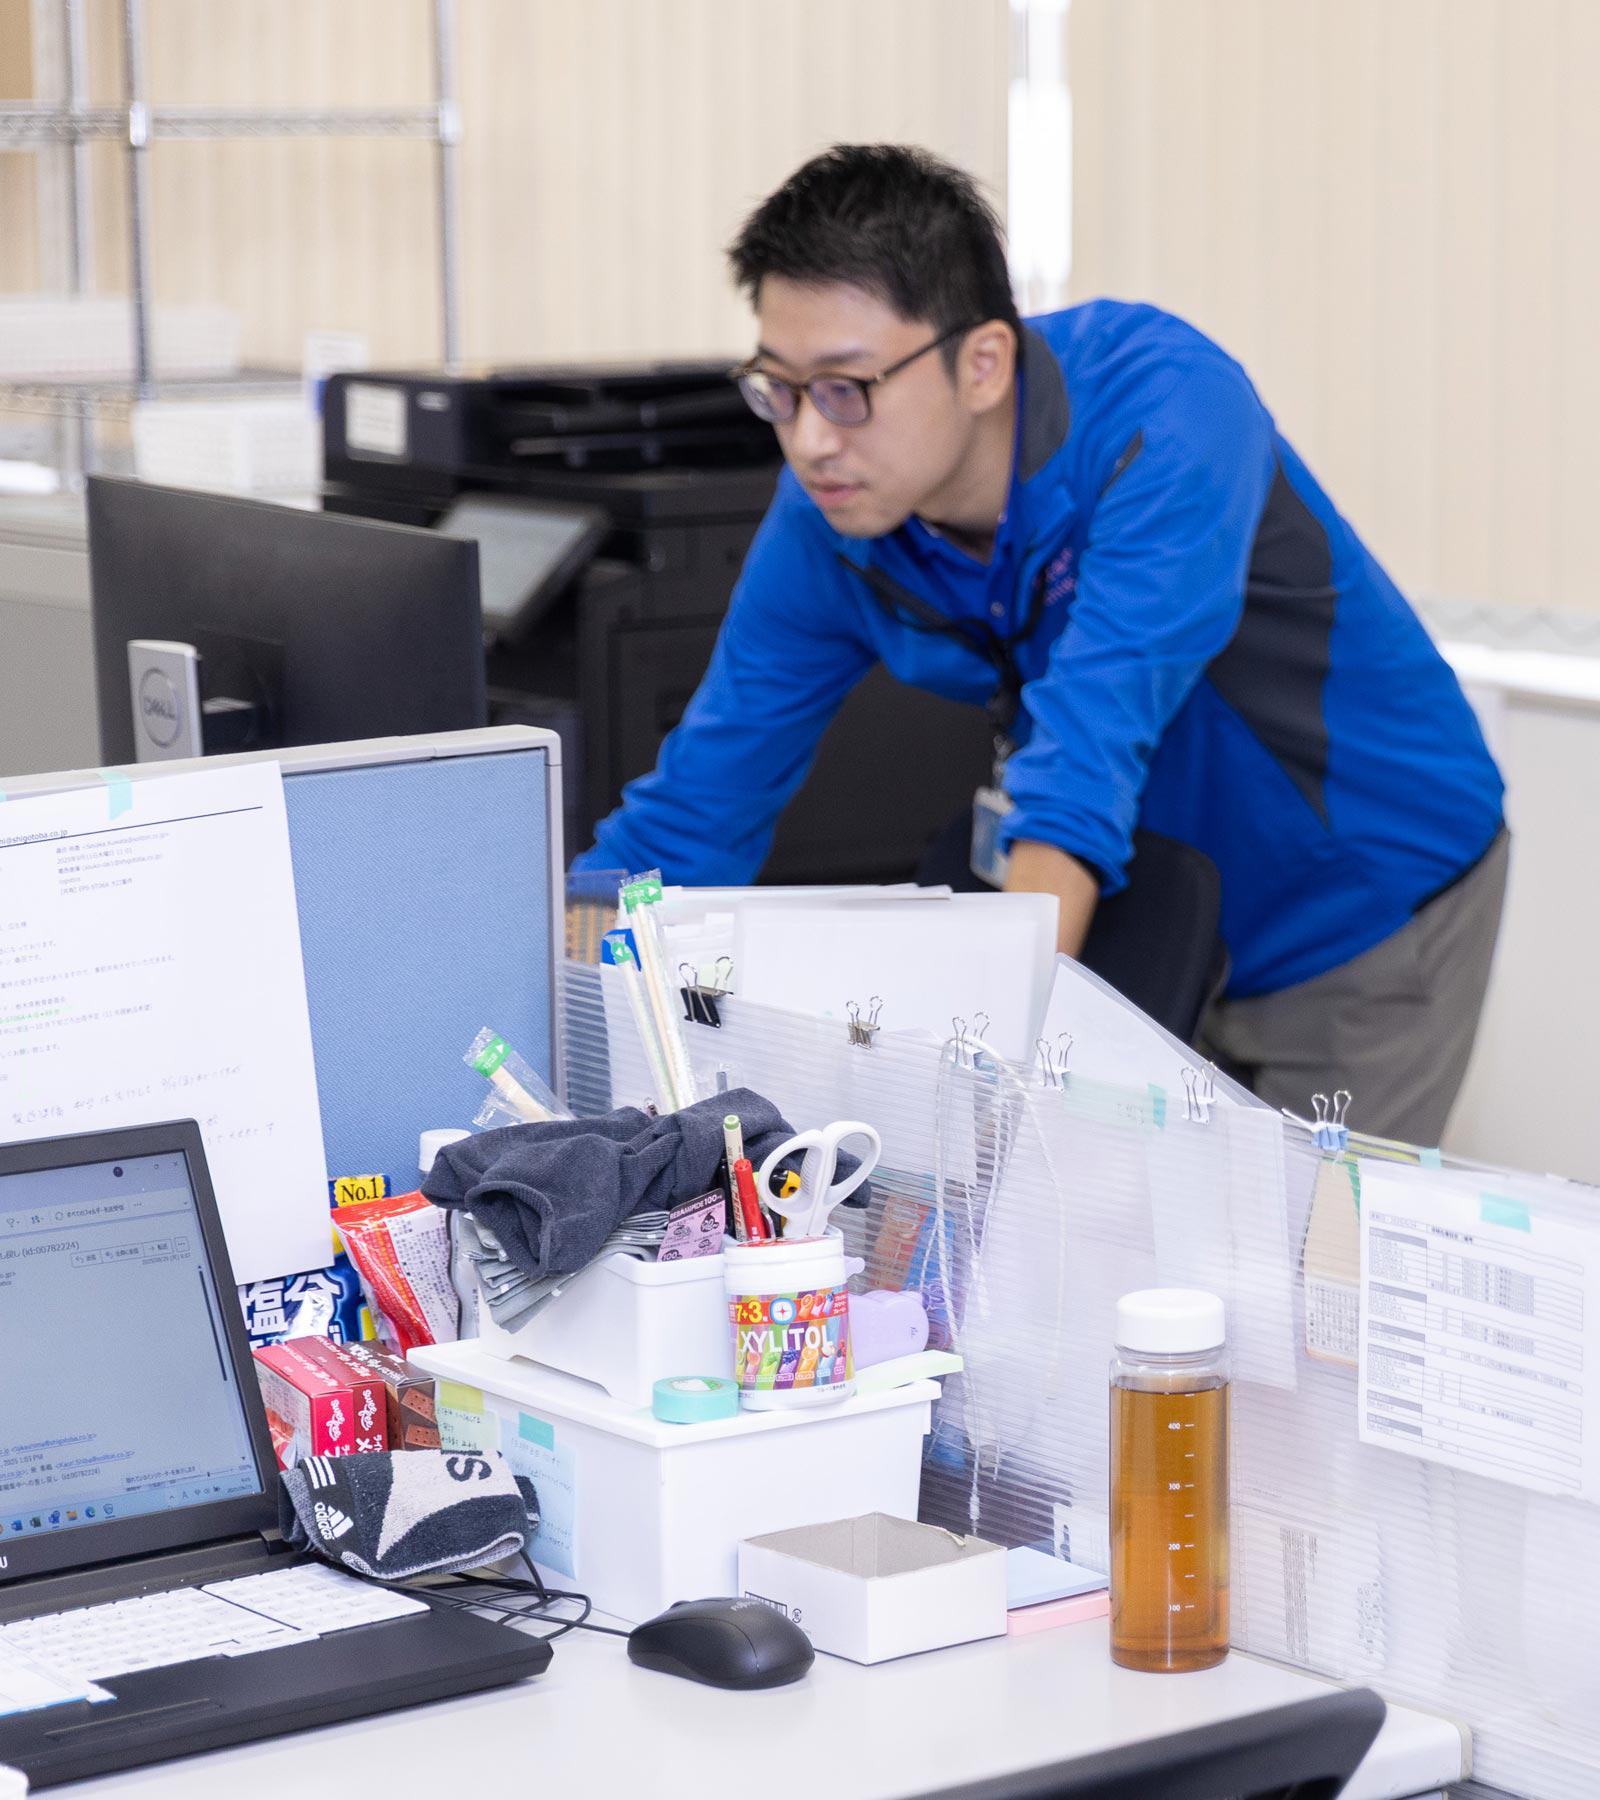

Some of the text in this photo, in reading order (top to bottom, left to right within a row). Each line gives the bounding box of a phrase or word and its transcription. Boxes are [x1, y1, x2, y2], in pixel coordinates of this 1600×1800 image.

[341, 1177, 380, 1203] No.1
[739, 1325, 834, 1355] XYLITOL
[1167, 1422, 1181, 1430] 400
[314, 1501, 335, 1540] adidas
[1168, 1542, 1181, 1550] 200
